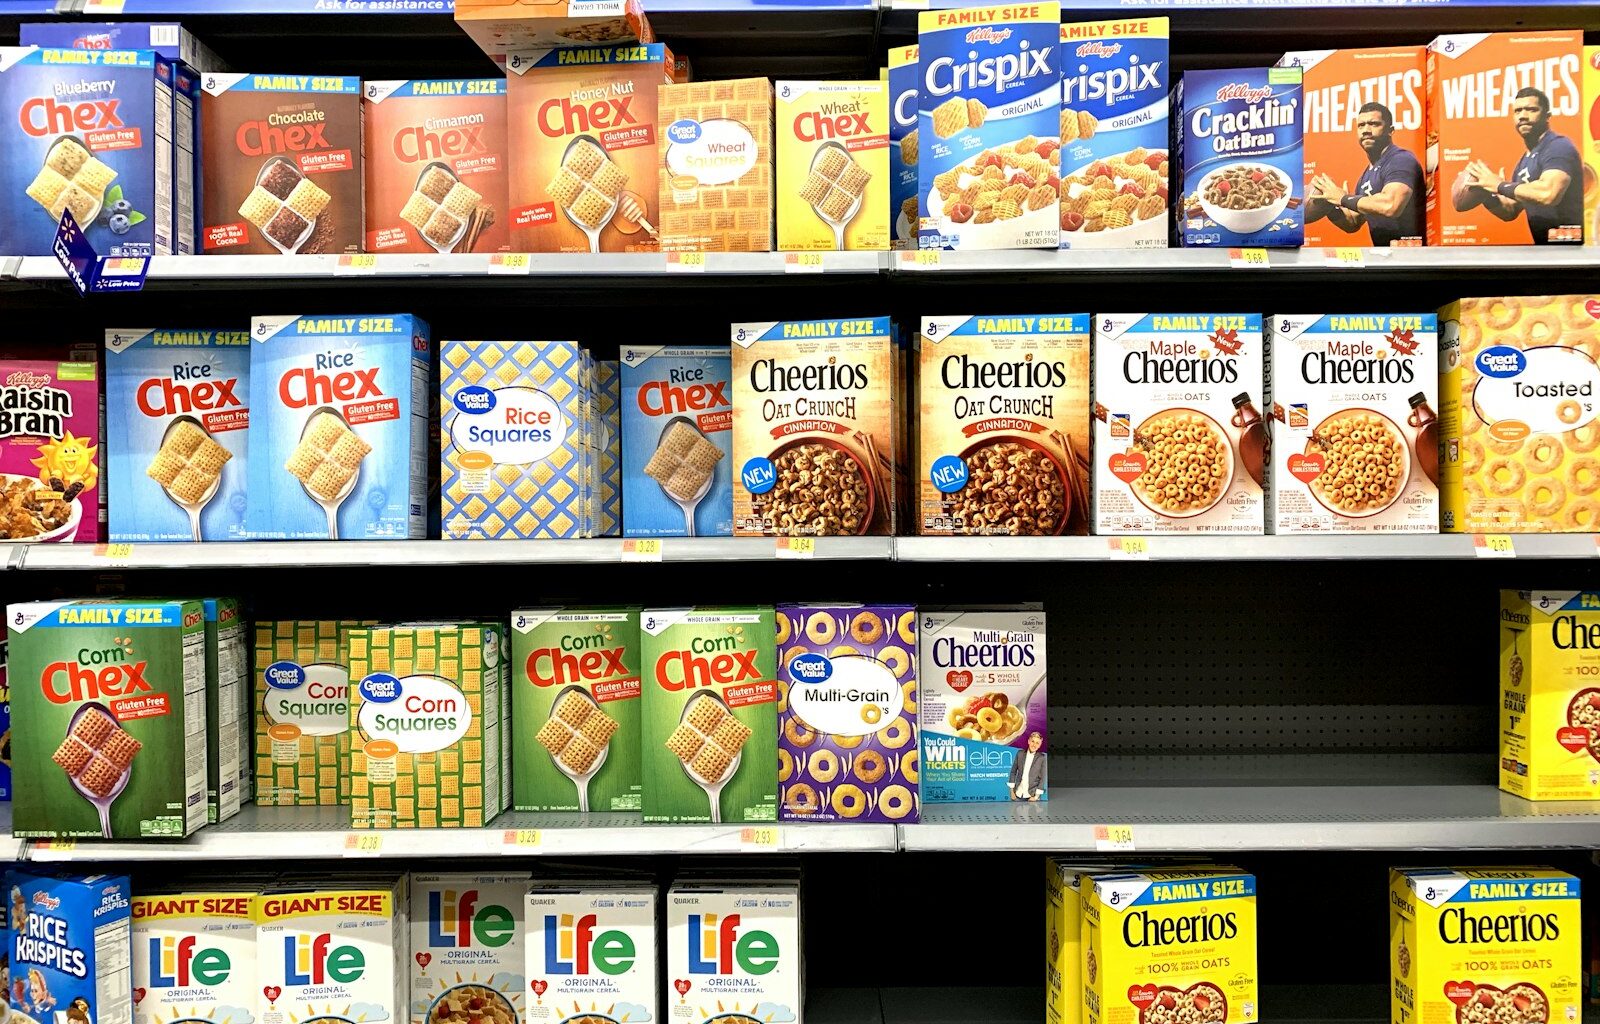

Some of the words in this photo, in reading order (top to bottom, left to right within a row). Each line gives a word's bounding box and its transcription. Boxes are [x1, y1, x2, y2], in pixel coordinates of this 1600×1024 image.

[315, 0, 342, 10] Ask
[346, 0, 371, 10] for
[373, 0, 443, 10] assistance
[938, 11, 997, 25] FAMILY
[1003, 6, 1040, 19] SIZE
[965, 27, 1012, 44] Kellogg's
[42, 50, 99, 65] FAMILY
[102, 50, 137, 66] SIZE
[558, 48, 613, 65] FAMILY
[615, 46, 648, 62] SIZE
[925, 39, 1053, 97] Crispix
[54, 79, 116, 97] Blueberry
[254, 76, 309, 91] FAMILY
[311, 77, 344, 91] SIZE
[413, 81, 464, 96] FAMILY
[466, 80, 497, 94] SIZE
[1442, 53, 1580, 120] WHEATIES
[571, 87, 611, 103] Honey
[611, 82, 634, 96] Nut
[1216, 83, 1272, 104] Kellogg's
[820, 100, 861, 115] Wheat
[1002, 98, 1044, 116] ORIGINAL
[19, 97, 125, 137] Chex
[268, 110, 325, 126] Chocolate
[424, 113, 484, 131] Cinnamon
[538, 96, 637, 138] Chex
[1191, 98, 1298, 138] Cracklin'
[604, 130, 630, 142] Gluten
[631, 128, 647, 137] Free
[670, 124, 696, 136] Great
[794, 110, 872, 143] Chex
[235, 120, 332, 156] Chex
[393, 125, 488, 163] Chex
[677, 132, 698, 140] Value
[1213, 135, 1242, 153] Oat
[1241, 132, 1275, 149] Bran
[708, 142, 746, 154] Wheat
[685, 155, 746, 168] Squares
[516, 216, 531, 224] Real
[531, 212, 553, 222] Honey
[506, 255, 522, 266] 3.98
[685, 254, 701, 265] 2.38
[804, 254, 820, 265] 3.28
[1247, 252, 1263, 264] 3.68
[297, 320, 356, 334] FAMILY
[358, 319, 393, 333] SIZE
[783, 321, 838, 338] FAMILY
[841, 320, 873, 335] SIZE
[977, 318, 1035, 333] FAMILY
[1038, 317, 1073, 332] SIZE
[1153, 317, 1208, 331] FAMILY
[1213, 316, 1247, 330] SIZE
[1330, 317, 1386, 331] FAMILY
[1389, 316, 1422, 330] SIZE
[153, 331, 211, 345] FAMILY
[215, 330, 249, 345] SIZE
[1217, 334, 1236, 350] New!
[1150, 341, 1197, 360] Maple
[1328, 341, 1373, 360] Maple
[316, 350, 354, 370] Rice
[1123, 350, 1238, 384] Cheerios
[1301, 350, 1415, 384] Cheerios
[1481, 353, 1519, 366] Great
[1490, 362, 1519, 372] Value
[7, 371, 51, 388] Kellogg's
[173, 362, 211, 381] Rice
[669, 367, 704, 383] Rice
[751, 356, 868, 393] Cheerios
[941, 353, 1066, 390] Cheerios
[278, 367, 384, 409] Chex
[1513, 381, 1593, 398] Toasted
[136, 377, 242, 418] Chex
[457, 392, 490, 403] Great
[465, 400, 490, 409] Value
[637, 381, 731, 417] Chex
[348, 405, 376, 416] Gluten
[376, 402, 394, 411] Free
[505, 407, 552, 425] Rice
[469, 425, 553, 445] Squares
[783, 421, 837, 434] CINNAMON
[743, 465, 774, 487] NEW
[932, 461, 966, 486] NEW
[112, 543, 129, 556] 3.98
[639, 540, 655, 552] 3.28
[794, 539, 810, 550] 3.64
[1126, 541, 1143, 554] 3.64
[1491, 539, 1508, 552] 2.87
[59, 608, 123, 624] FAMILY
[125, 608, 163, 624] SIZE
[1501, 608, 1530, 625] Cheerios
[561, 632, 604, 651] Corn
[691, 635, 736, 654] Corn
[973, 631, 1000, 643] Multi
[1006, 631, 1034, 643] Grain
[78, 647, 125, 666] Corn
[932, 637, 1035, 668] Cheerios
[525, 647, 631, 689] Chex
[655, 650, 763, 693] Chex
[794, 659, 825, 672] Great
[802, 668, 826, 678] Value
[40, 660, 154, 706] Chex
[364, 680, 395, 691] Great
[371, 689, 396, 698] Value
[805, 689, 889, 702] Multi-Grain
[1504, 690, 1526, 704] WHOLE
[116, 700, 144, 711] Gluten
[146, 697, 165, 707] Free
[405, 695, 456, 713] Corn
[1504, 699, 1526, 714] GRAIN
[375, 714, 457, 735] Squares
[924, 737, 936, 746] You
[937, 737, 956, 746] Could
[970, 747, 1012, 767] ellen
[926, 762, 965, 770] TICKETS
[361, 837, 378, 850] 2.38
[520, 830, 536, 843] 3.28
[755, 830, 771, 843] 2.93
[1115, 830, 1132, 843] 3.64
[101, 892, 121, 906] RICE
[1152, 882, 1209, 902] FAMILY
[1212, 879, 1245, 897] SIZE
[1470, 883, 1530, 899] FAMILY
[1531, 882, 1568, 897] SIZE
[94, 897, 129, 918] KRISPIES
[131, 900, 200, 918] GIANT
[264, 898, 334, 917] GIANT
[429, 889, 516, 948] Life
[1439, 906, 1560, 944] Cheerios
[28, 913, 67, 946] RICE
[1123, 906, 1238, 949] Cheerios
[544, 913, 636, 975] Life
[688, 913, 780, 975] Life
[16, 936, 87, 977] KRISPIES
[149, 935, 231, 988] Life
[284, 933, 366, 987] Life
[447, 951, 494, 959] ORIGINAL
[1147, 961, 1179, 974] 100%
[1201, 958, 1230, 970] OATS
[1465, 961, 1498, 971] 100%
[1522, 959, 1553, 970] OATS
[564, 978, 613, 987] ORIGINAL
[708, 978, 757, 987] ORIGINAL
